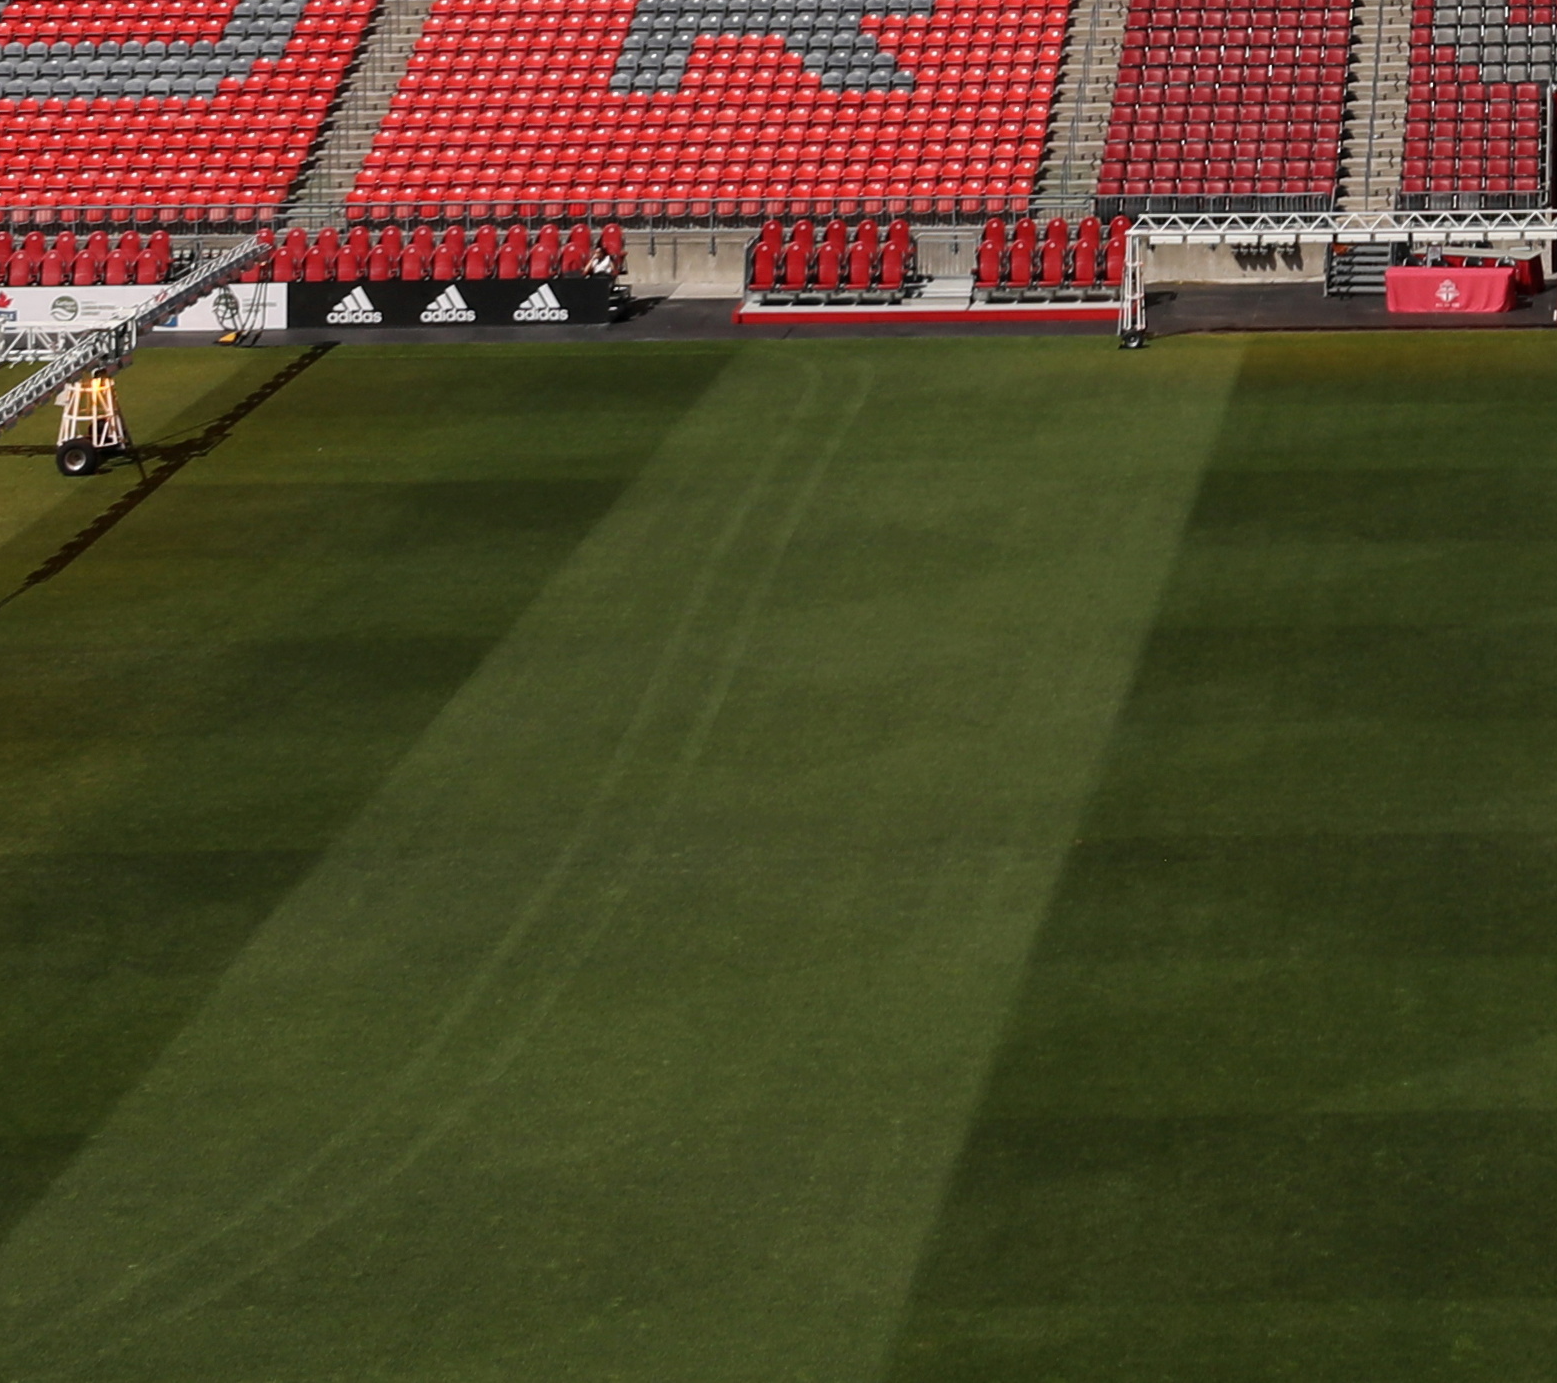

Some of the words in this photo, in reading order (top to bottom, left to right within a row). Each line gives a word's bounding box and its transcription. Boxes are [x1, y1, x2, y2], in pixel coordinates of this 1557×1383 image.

[326, 310, 382, 324] adidas
[420, 309, 476, 323] adidas
[513, 308, 569, 322] adidas
